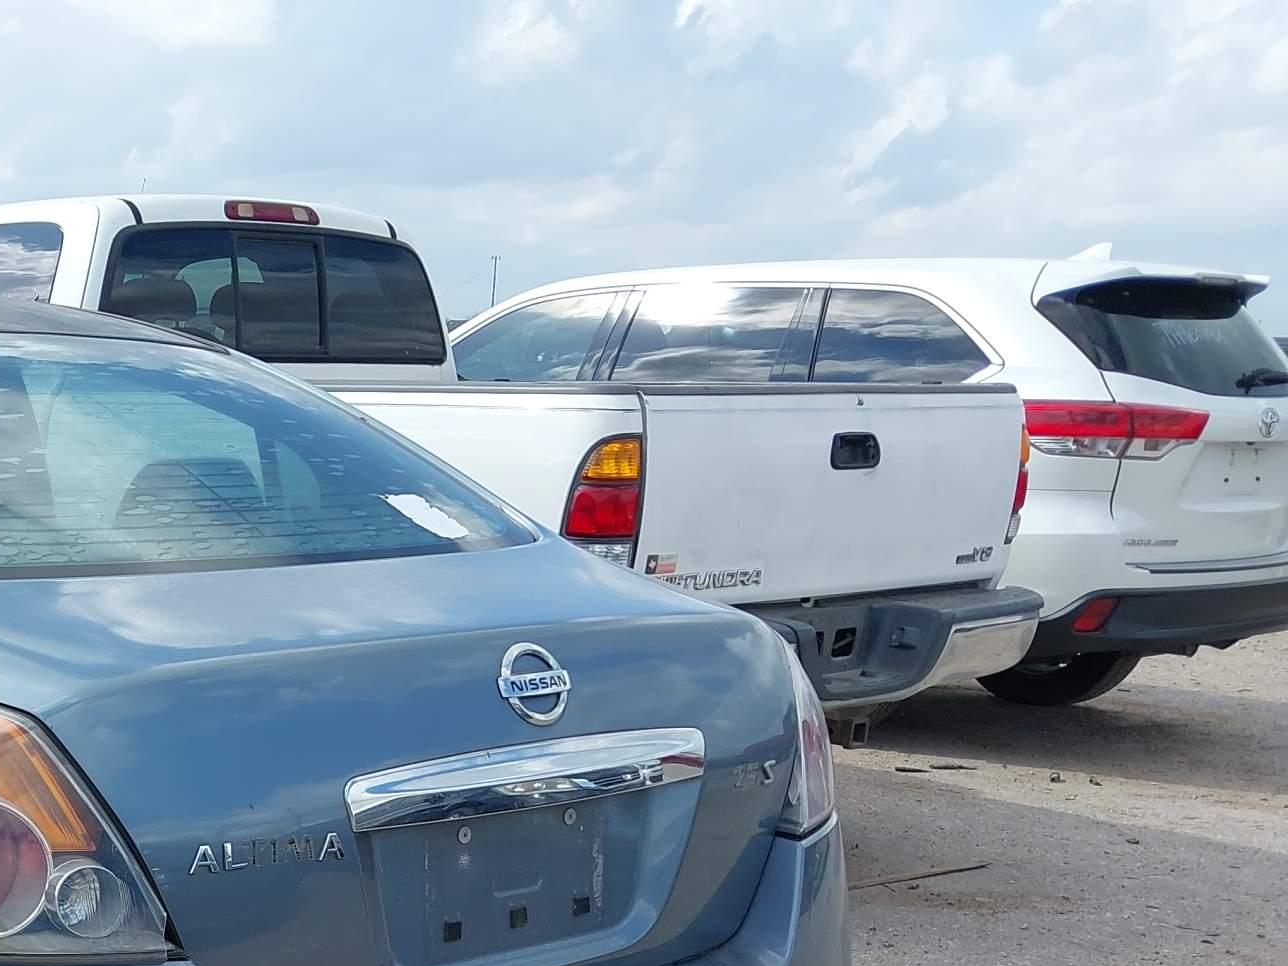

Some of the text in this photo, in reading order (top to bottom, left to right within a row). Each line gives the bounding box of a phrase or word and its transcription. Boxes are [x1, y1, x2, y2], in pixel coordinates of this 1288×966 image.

[682, 567, 763, 590] TUNDRA
[510, 674, 568, 692] NISSAN
[188, 832, 345, 875] ALTIMA
